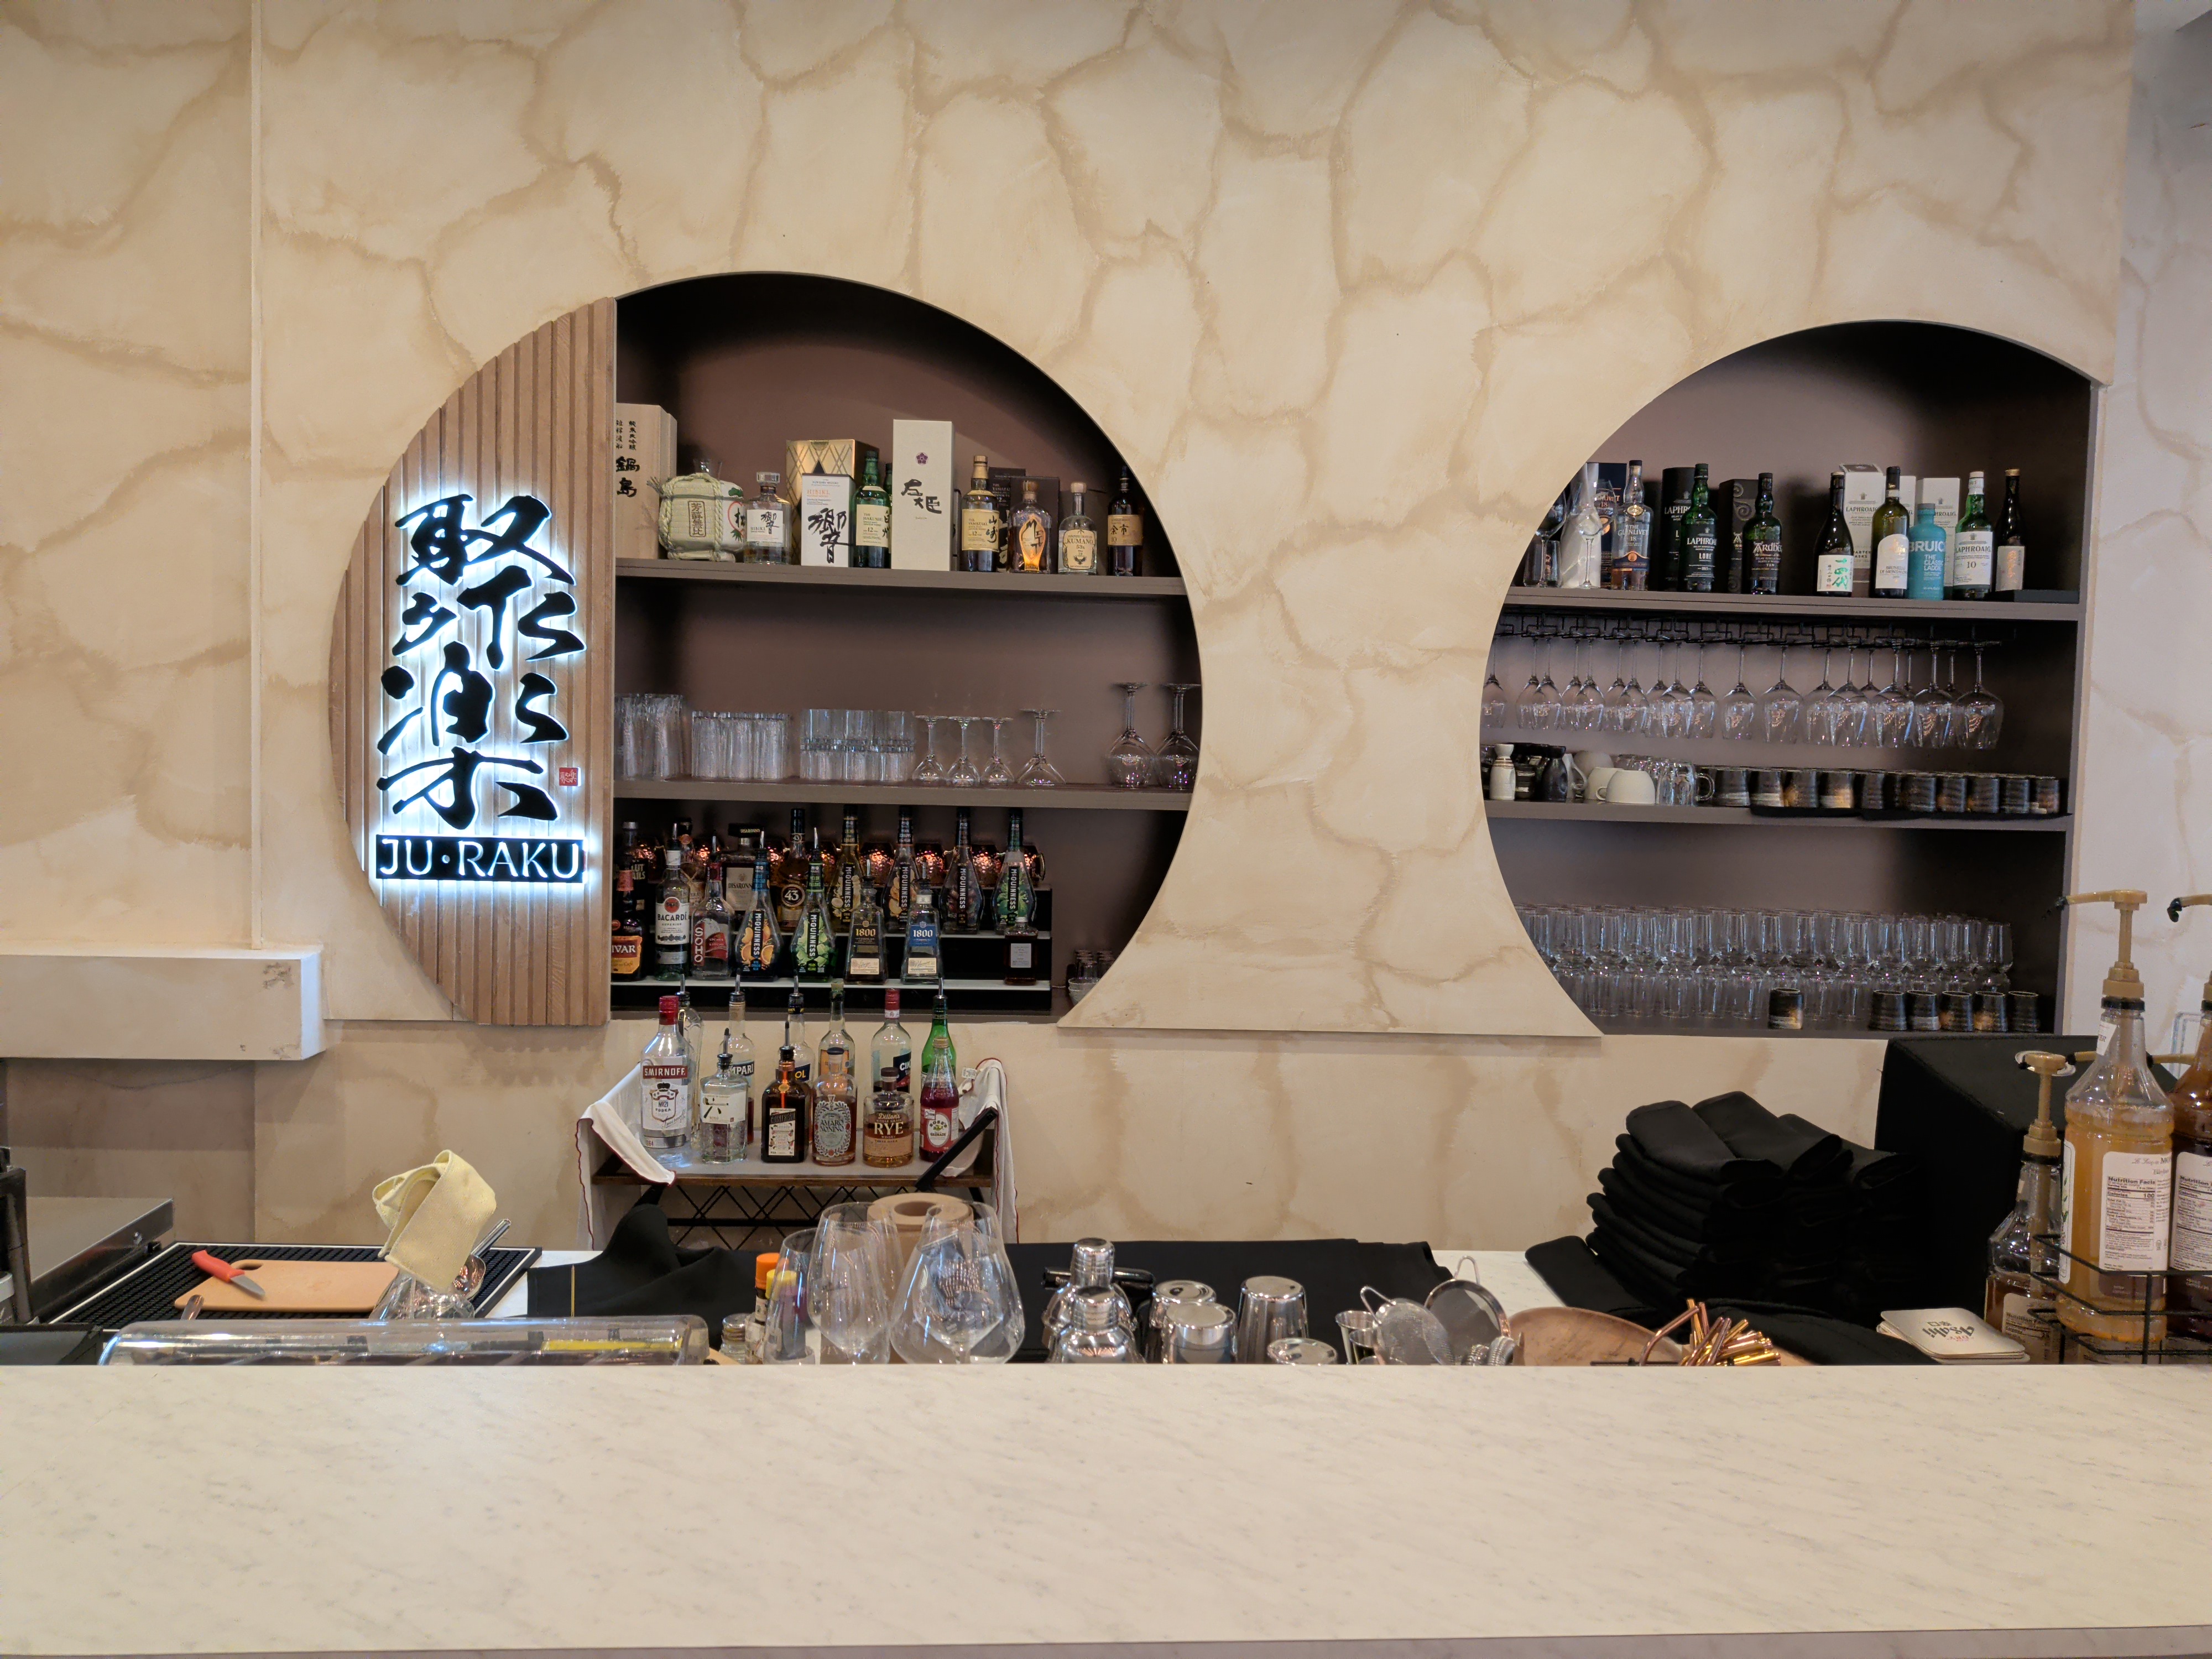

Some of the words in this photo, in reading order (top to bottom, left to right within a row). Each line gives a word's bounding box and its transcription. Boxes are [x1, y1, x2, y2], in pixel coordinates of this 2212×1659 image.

[1110, 524, 1129, 535] 余市
[784, 890, 800, 901] 43
[612, 945, 636, 953] IVAR
[695, 927, 703, 963] SOHO
[731, 1063, 754, 1074] MPARI
[874, 1122, 904, 1135] RYE
[2180, 1176, 2209, 1186] Nutrition
